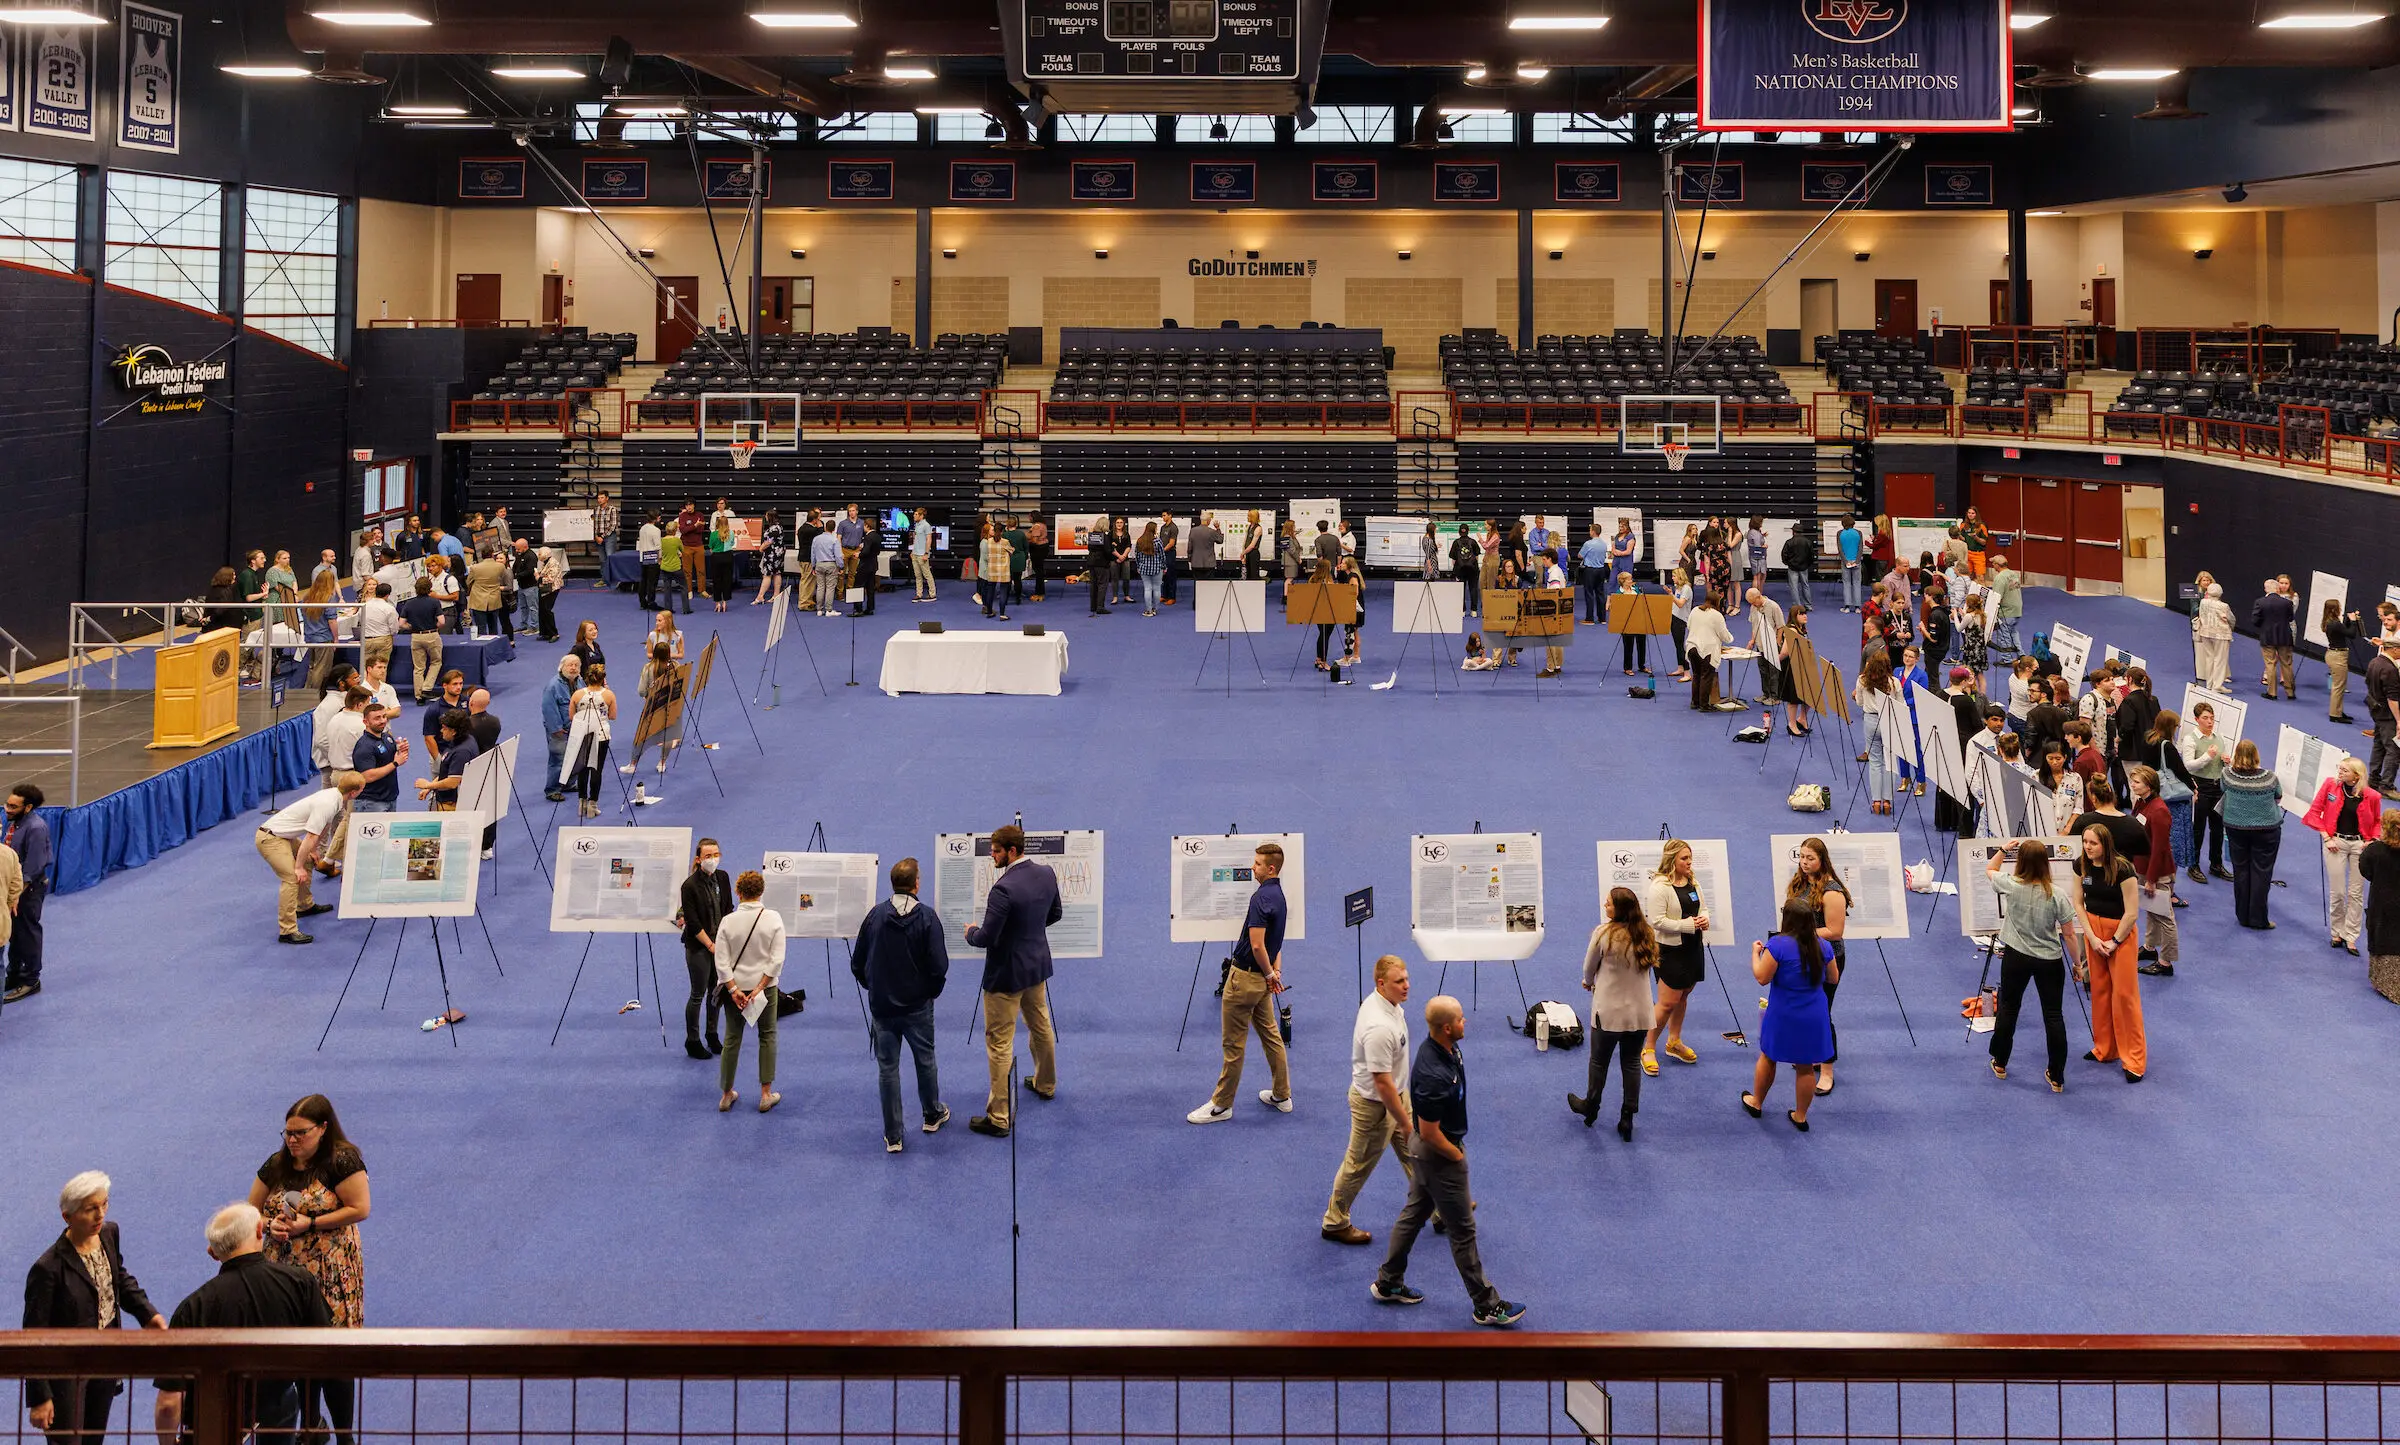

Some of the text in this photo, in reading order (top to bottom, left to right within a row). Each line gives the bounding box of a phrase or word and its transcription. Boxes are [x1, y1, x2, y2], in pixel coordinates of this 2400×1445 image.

[1065, 2, 1098, 10] BONUS
[1223, 3, 1256, 11] BONUS
[132, 13, 173, 36] HOOVER
[1047, 18, 1098, 26] TIMEOUTS
[1222, 18, 1273, 27] TIMEOUTS
[1173, 43, 1205, 51] FOULS
[43, 45, 82, 67] LEBANON
[1792, 53, 1920, 69] Men's Basketball
[49, 59, 76, 89] 23
[134, 64, 168, 84] LEBANON
[1754, 74, 1959, 90] NATIONAL CHAMPIONS
[44, 89, 78, 105] VALLEY
[146, 79, 156, 104] 5
[1838, 96, 1873, 111] 1994
[33, 108, 88, 130] 2001-2005
[136, 105, 165, 120] VALLEY
[127, 124, 172, 144] 2007-2011
[135, 362, 226, 385] Lebanon Federal
[160, 382, 204, 396] Credit Union
[358, 452, 368, 460] EXIT
[363, 825, 382, 838] LVC
[577, 840, 596, 853] LVC
[949, 842, 968, 855] LVC
[1185, 842, 1204, 854] LVC
[1424, 845, 1445, 860] LVC
[774, 860, 791, 872] LVC
[1615, 854, 1633, 866] LVC
